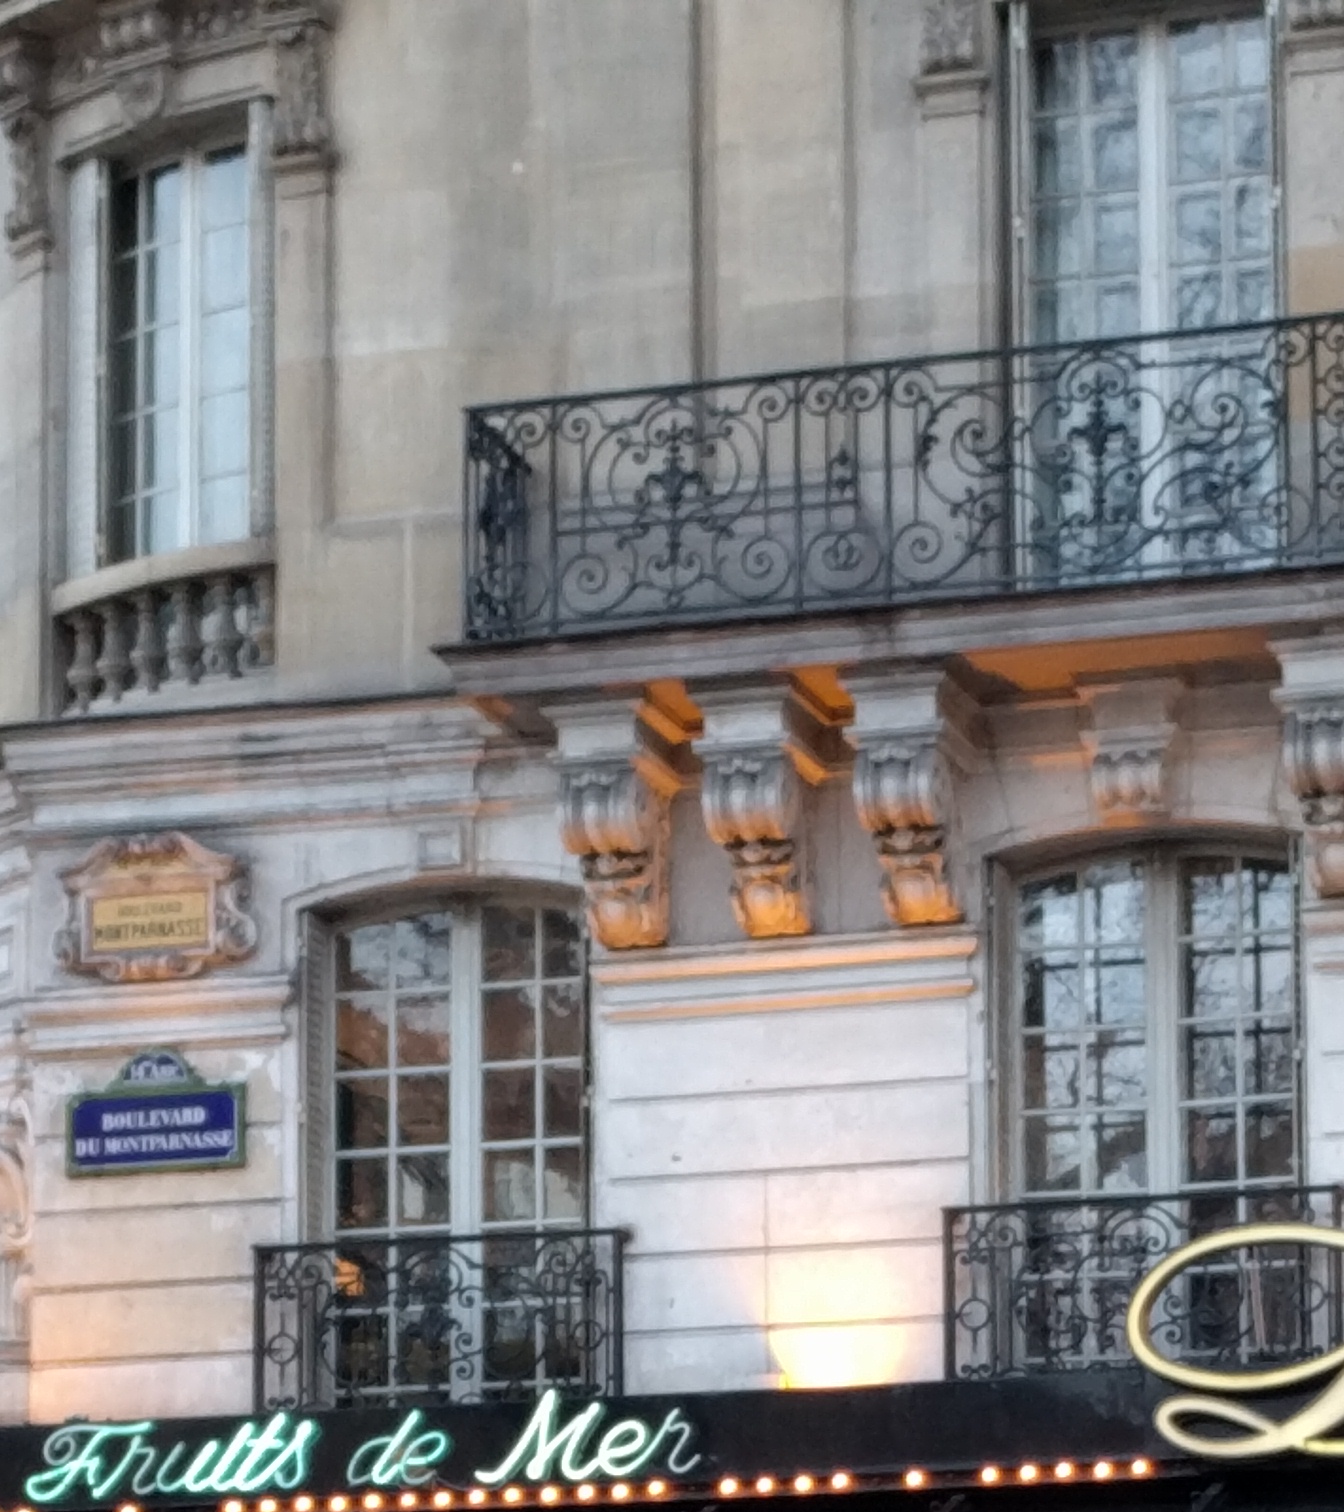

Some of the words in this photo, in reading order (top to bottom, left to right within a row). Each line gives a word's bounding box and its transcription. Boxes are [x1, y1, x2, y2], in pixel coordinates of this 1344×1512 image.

[102, 1106, 206, 1132] BOULEVARD
[75, 1137, 100, 1157] DU
[104, 1129, 233, 1155] MONTPARNASSE
[26, 1411, 317, 1502] Fruits
[346, 1408, 447, 1486] de
[474, 1388, 702, 1484] Mer
